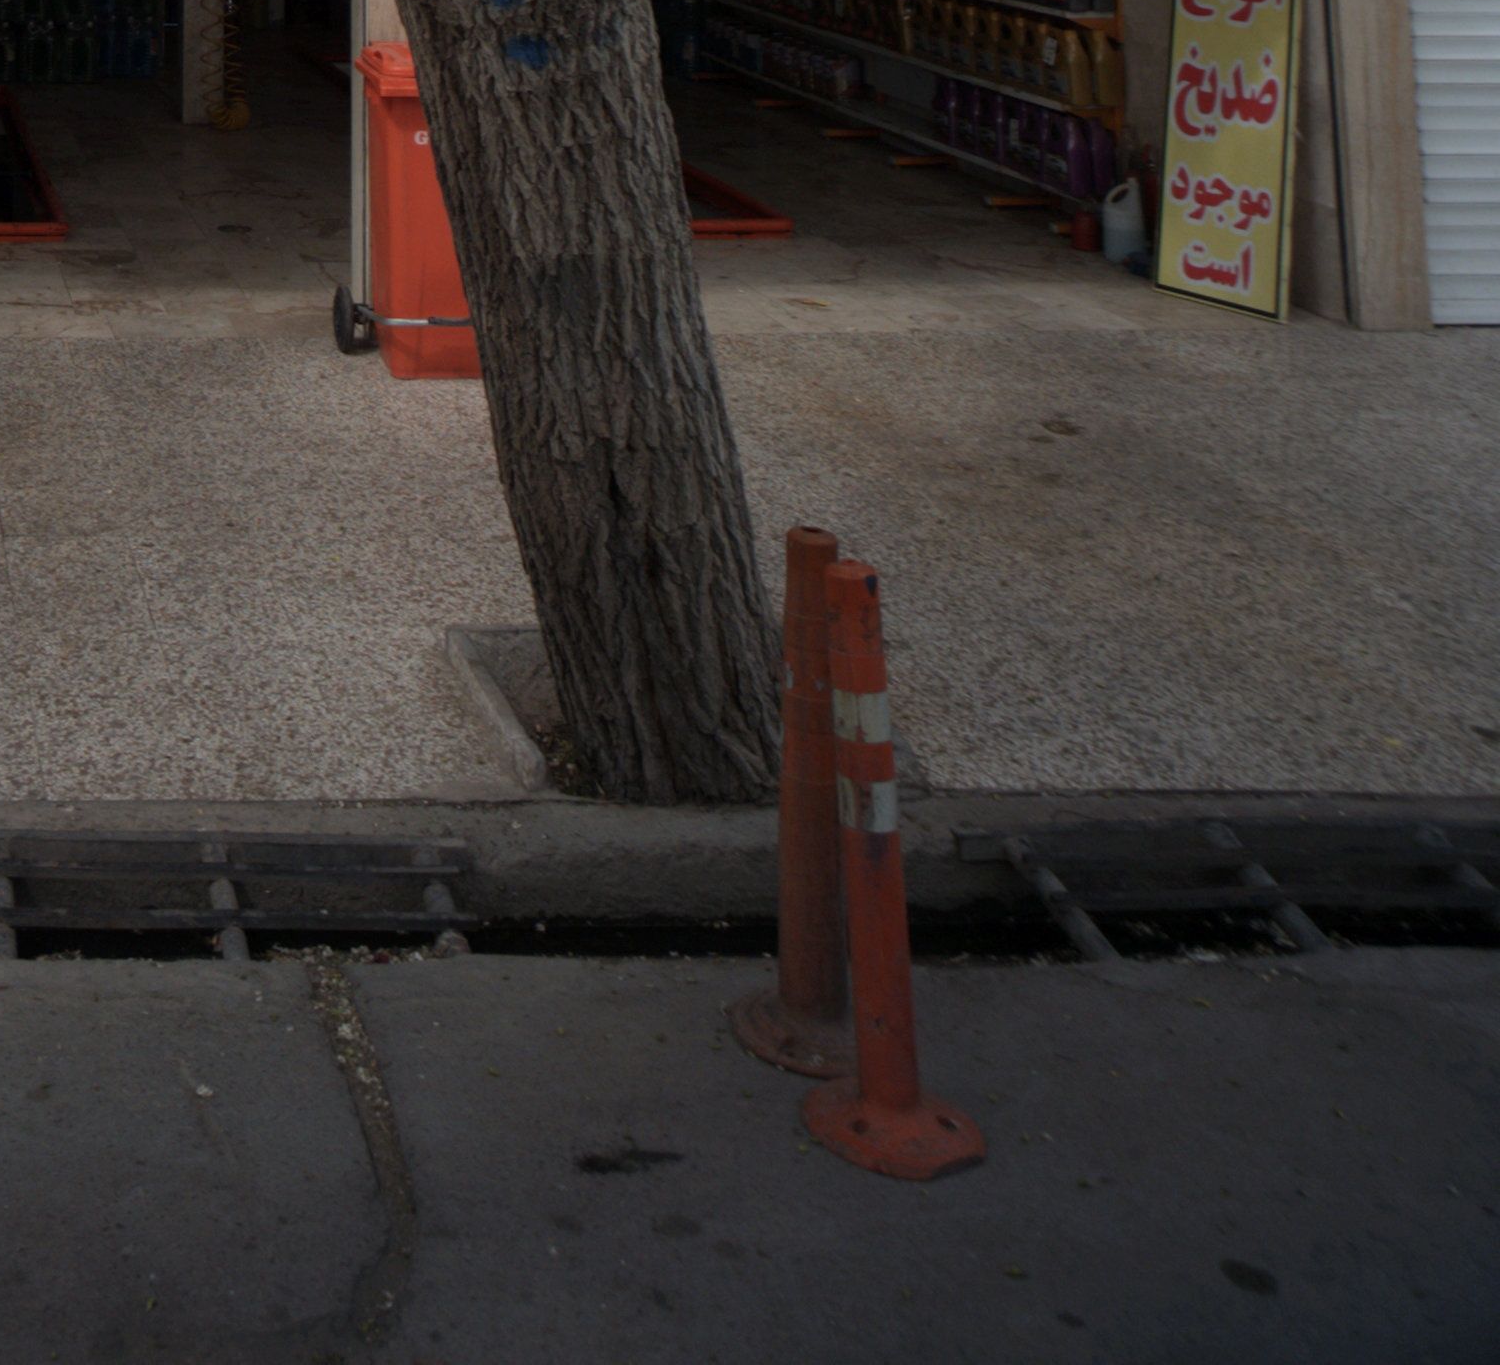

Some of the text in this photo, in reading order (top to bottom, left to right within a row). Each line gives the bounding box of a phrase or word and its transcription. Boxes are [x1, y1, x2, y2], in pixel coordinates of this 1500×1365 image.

[1174, 47, 1278, 137] ضدیخ
[1170, 167, 1271, 231] موجود
[1182, 245, 1252, 290] است
